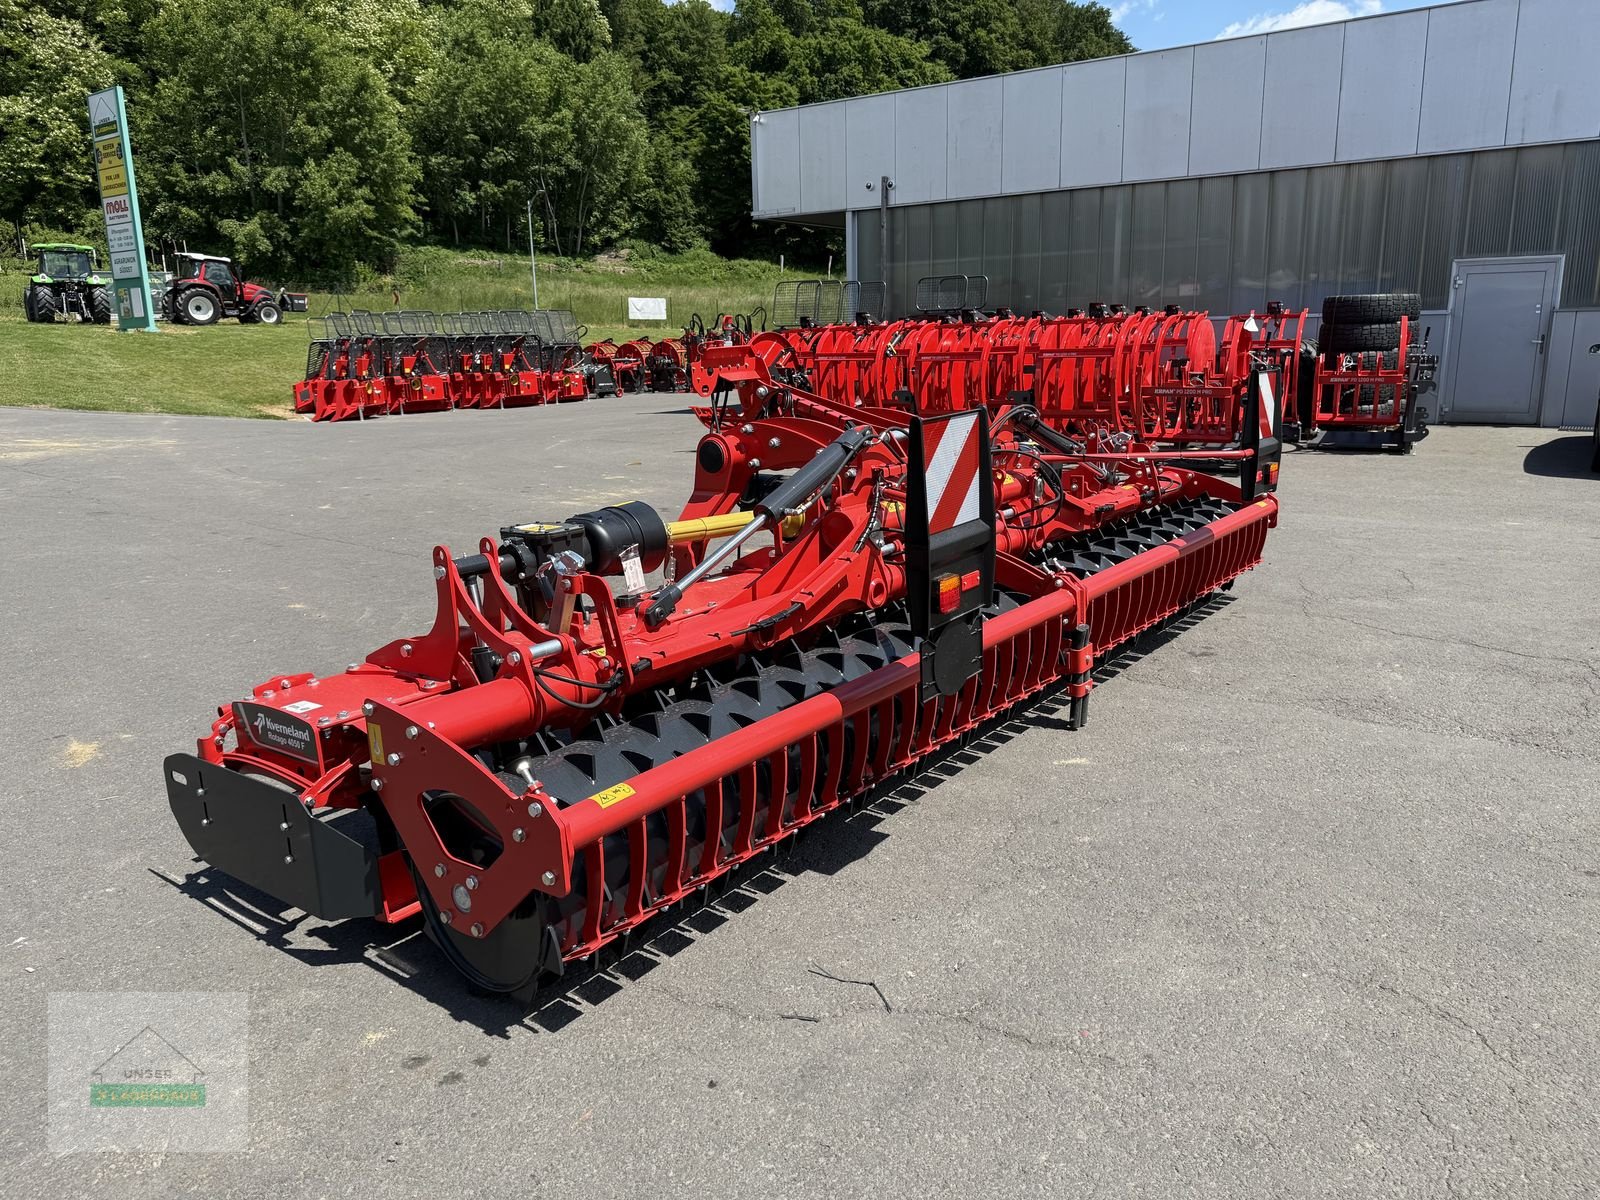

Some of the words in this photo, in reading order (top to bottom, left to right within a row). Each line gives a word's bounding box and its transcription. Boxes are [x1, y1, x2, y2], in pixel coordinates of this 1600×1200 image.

[102, 150, 116, 159] SERVICE
[113, 256, 136, 265] AGRARUNION
[265, 717, 310, 742] Kverneland
[267, 731, 287, 746] Rotago
[287, 738, 301, 750] 4050
[301, 741, 305, 750] F
